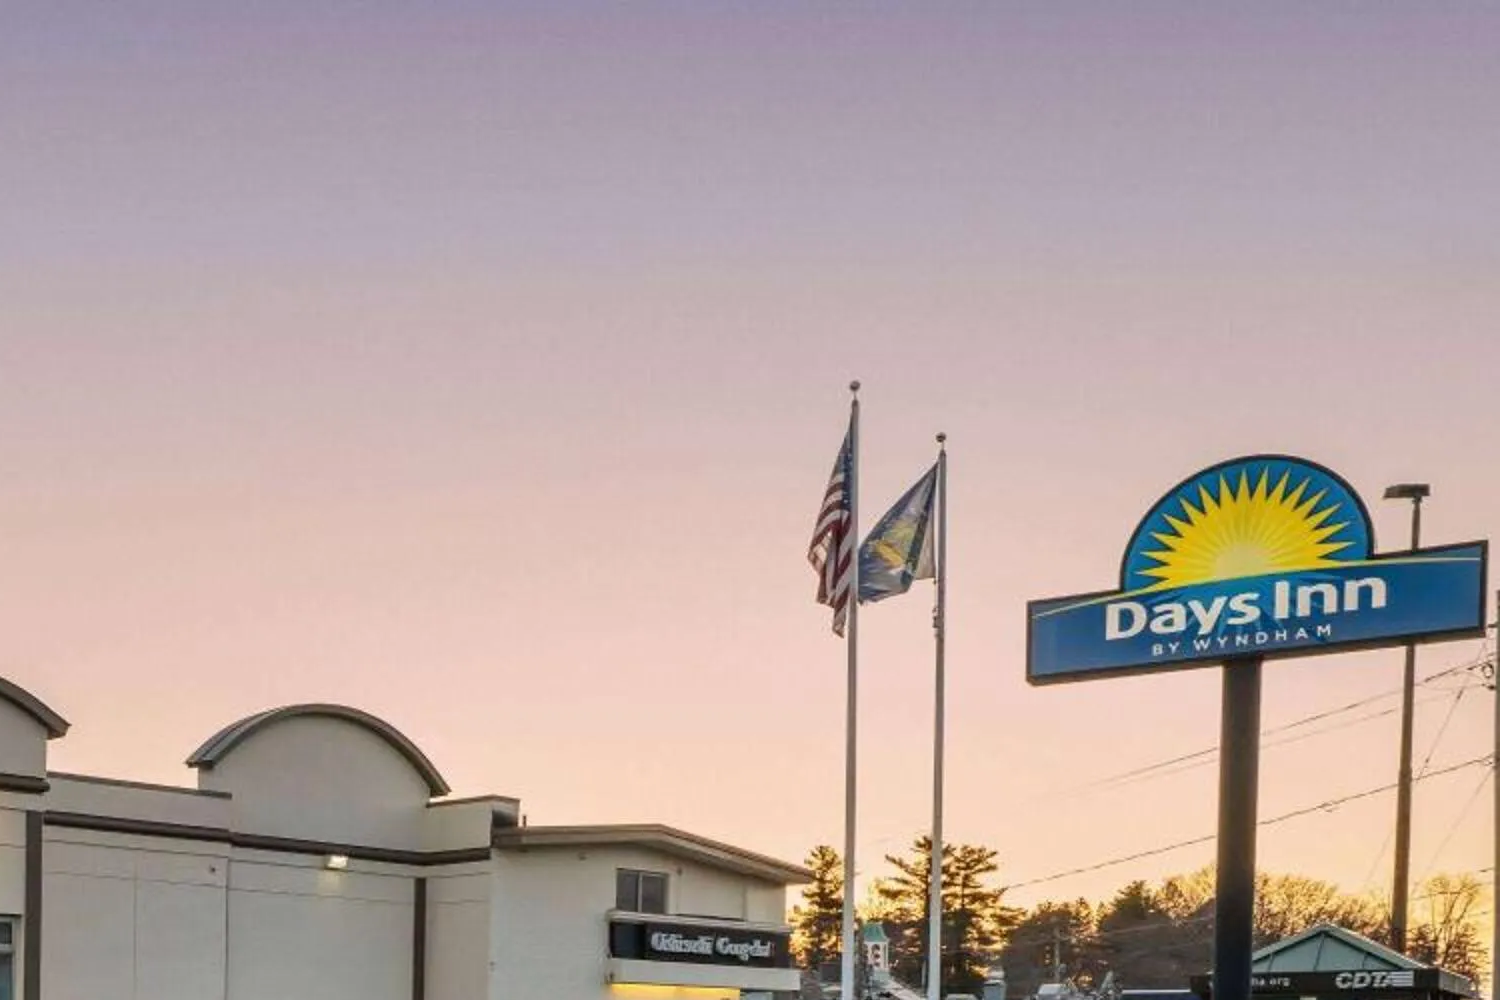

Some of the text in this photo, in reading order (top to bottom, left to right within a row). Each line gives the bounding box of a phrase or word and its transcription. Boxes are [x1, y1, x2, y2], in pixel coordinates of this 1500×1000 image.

[1104, 576, 1388, 641] Days Inn
[1151, 624, 1333, 657] BY WYNDHAM
